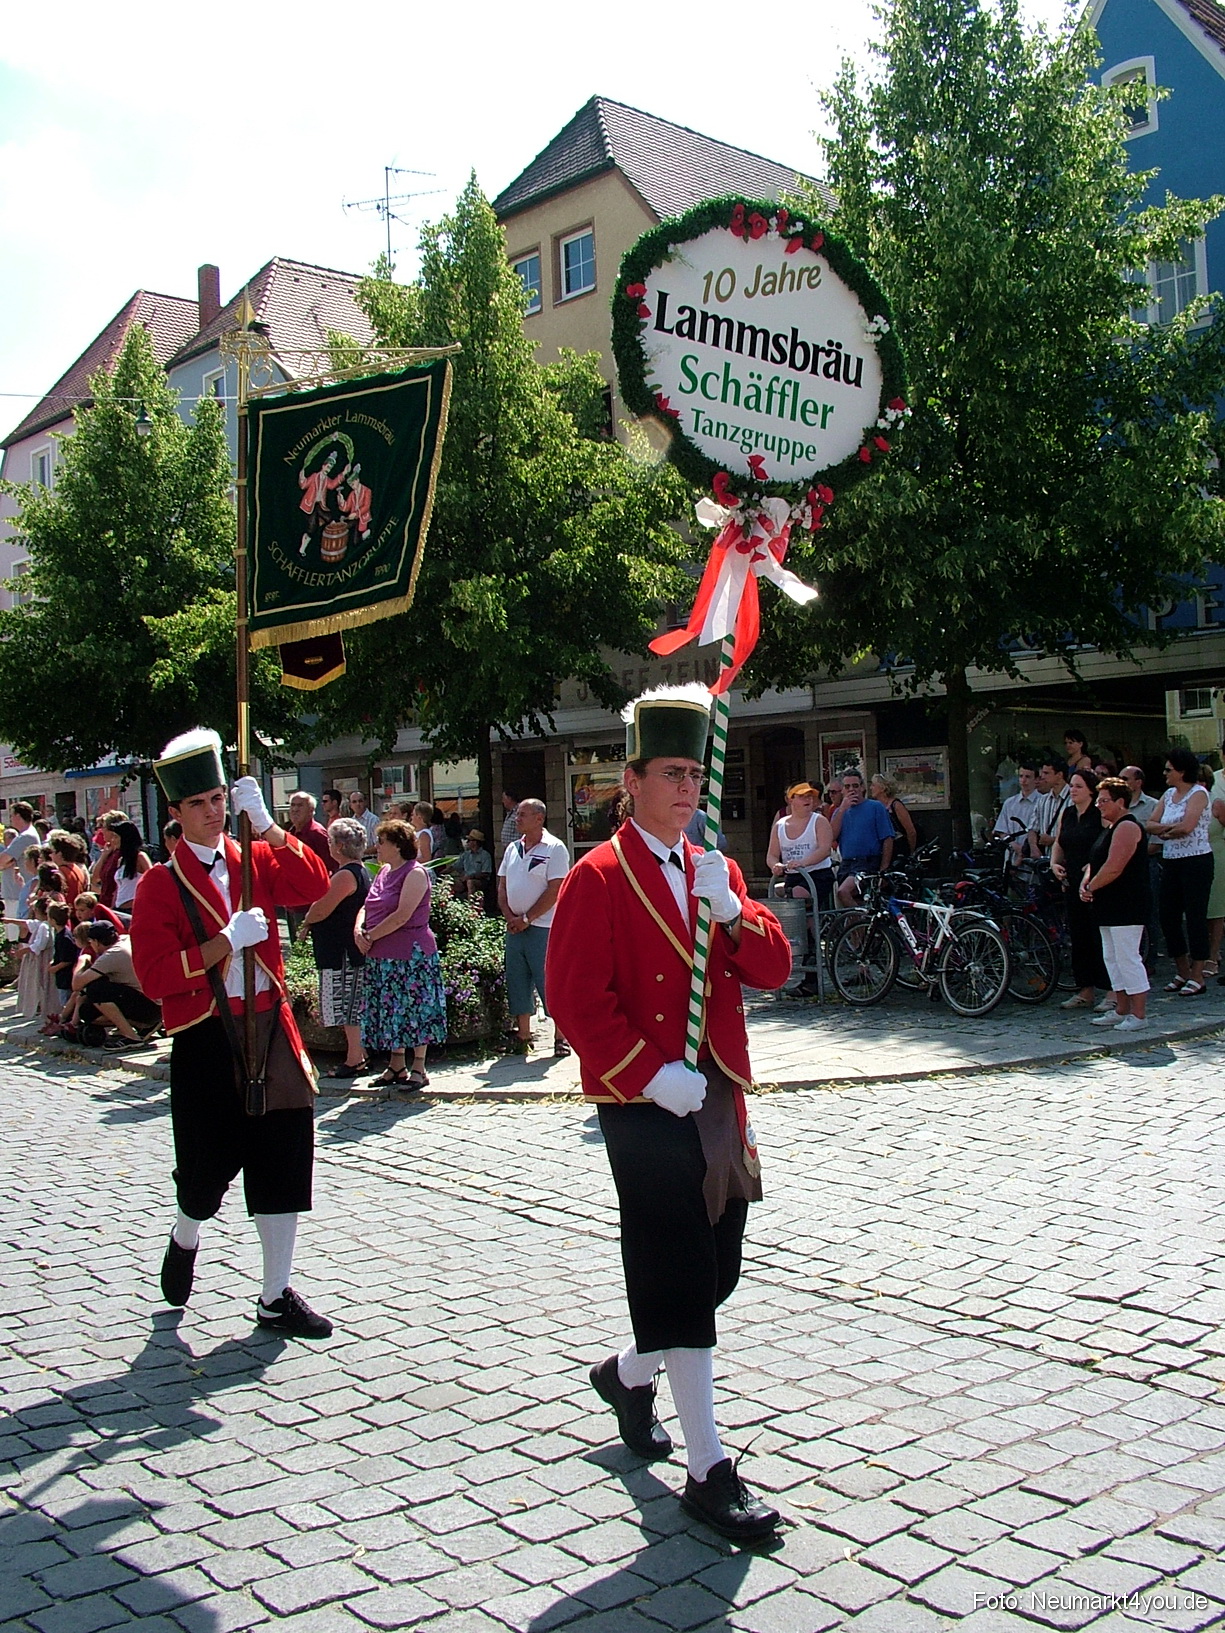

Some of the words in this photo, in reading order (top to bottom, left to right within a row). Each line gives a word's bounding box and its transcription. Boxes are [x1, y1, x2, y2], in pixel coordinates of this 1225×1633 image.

[702, 267, 736, 305] 10
[743, 261, 822, 299] Jahre
[653, 289, 864, 389] Lammsbräu
[677, 354, 835, 431] Schäffler
[283, 414, 342, 466] Neumarkter
[345, 409, 396, 446] Lammsbräu
[690, 407, 817, 466] Tanzgruppe
